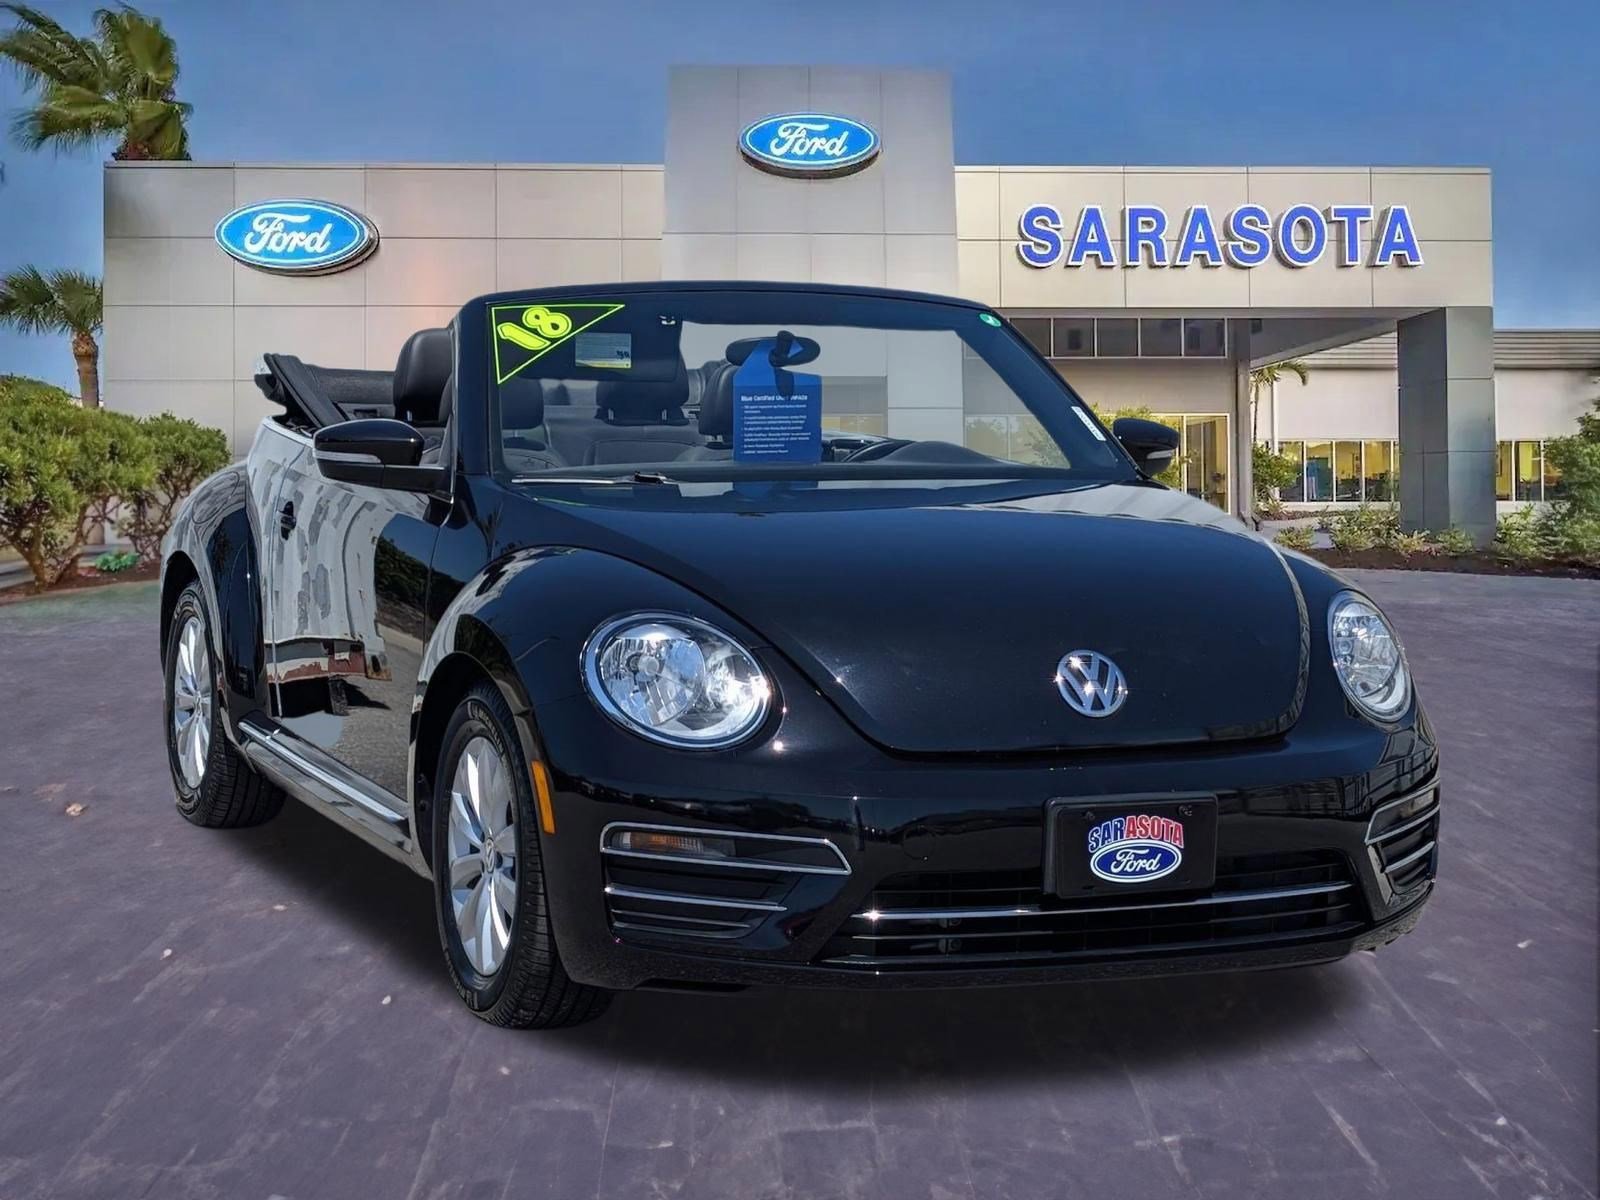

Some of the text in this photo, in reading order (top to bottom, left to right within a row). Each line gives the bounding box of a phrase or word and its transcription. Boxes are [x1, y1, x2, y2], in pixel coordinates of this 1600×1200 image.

[769, 122, 849, 157] Ford
[244, 212, 333, 254] Ford
[1017, 204, 1424, 268] SARASOTA
[497, 306, 572, 350] 18
[1088, 814, 1184, 853] SARASOTA
[1110, 848, 1162, 874] Ford
